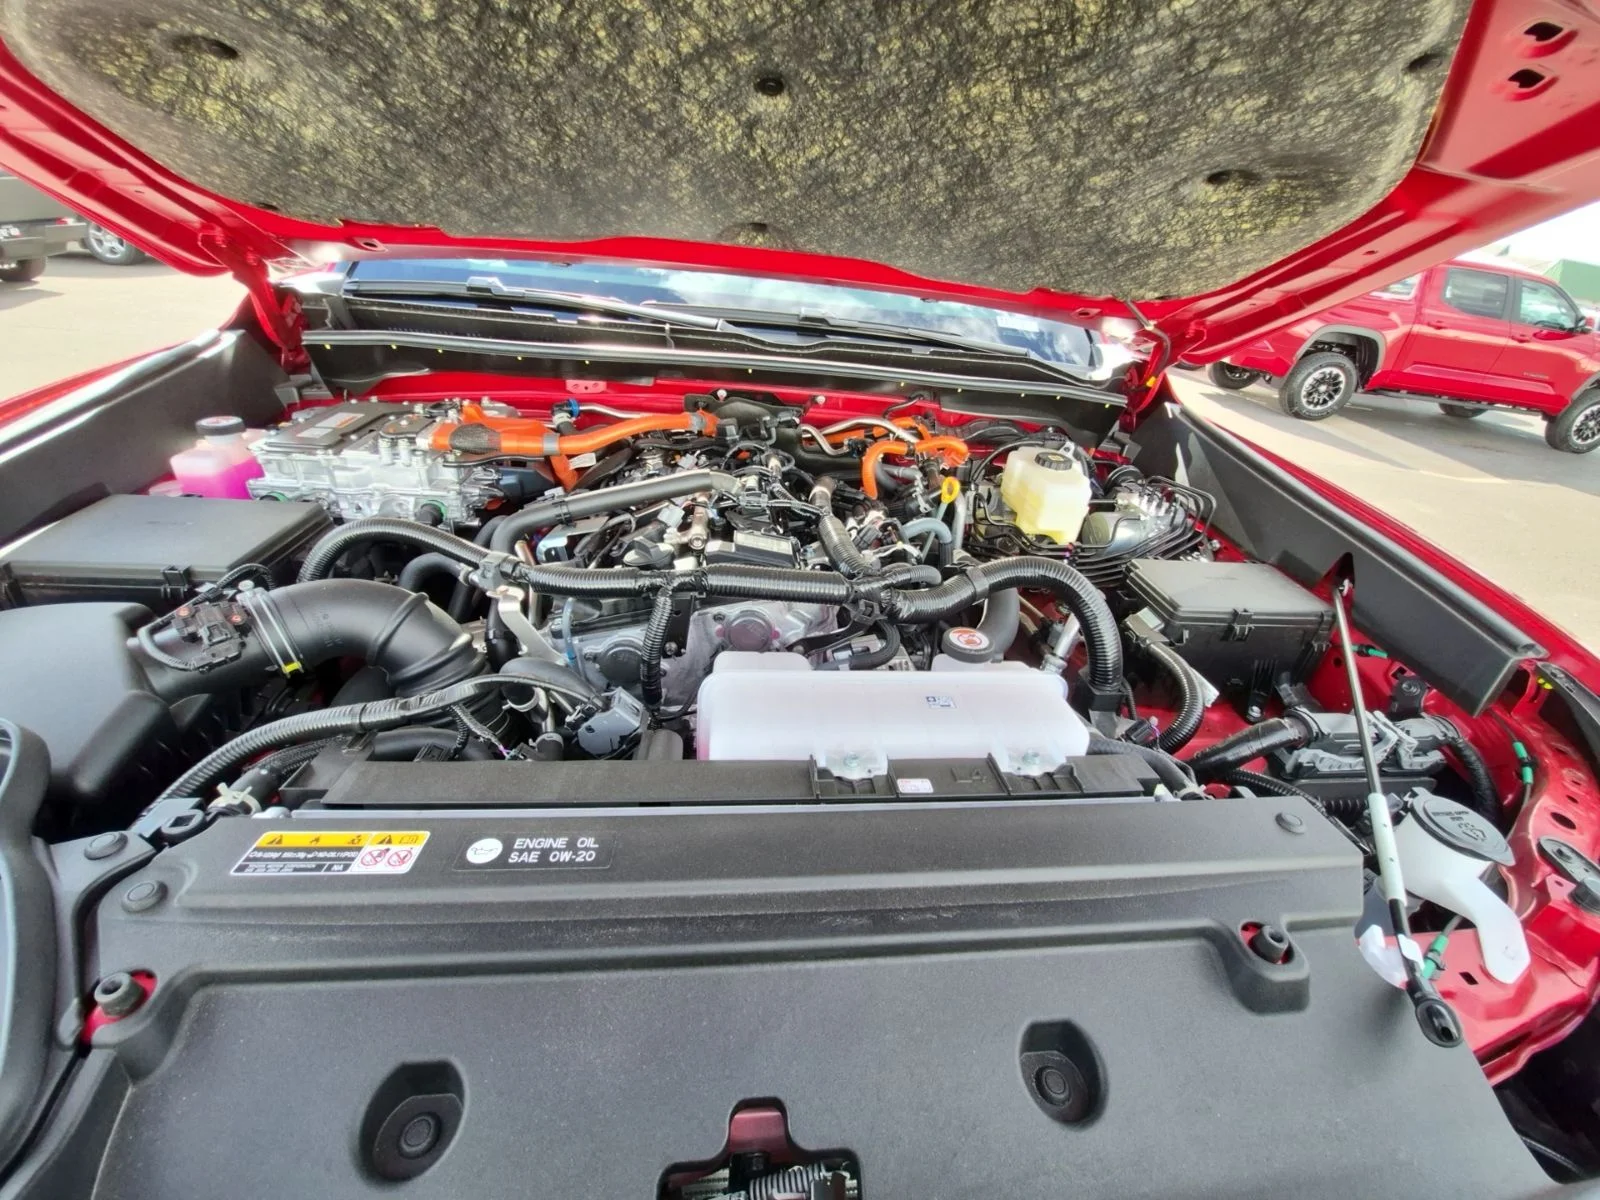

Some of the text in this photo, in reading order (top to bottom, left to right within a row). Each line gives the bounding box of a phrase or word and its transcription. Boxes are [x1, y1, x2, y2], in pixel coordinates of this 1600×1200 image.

[513, 837, 599, 849] ENGINE OIL
[508, 850, 596, 863] SAE 0W-20
